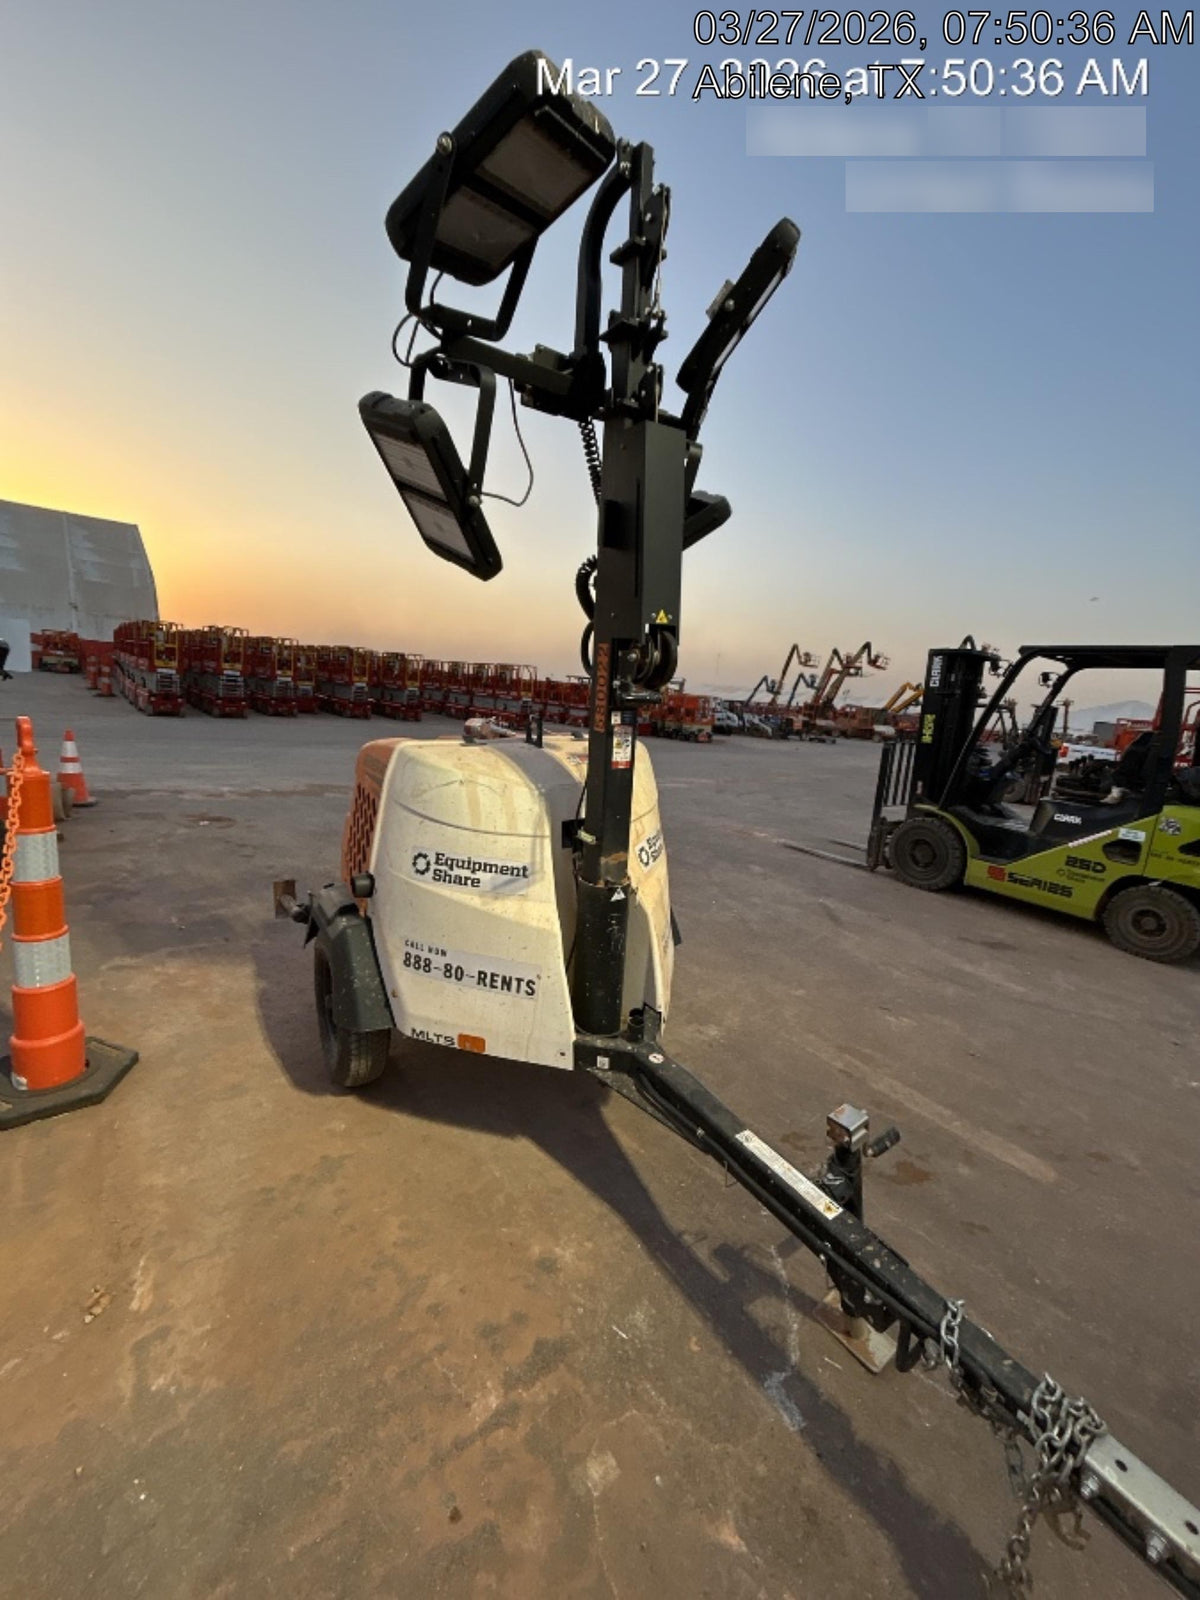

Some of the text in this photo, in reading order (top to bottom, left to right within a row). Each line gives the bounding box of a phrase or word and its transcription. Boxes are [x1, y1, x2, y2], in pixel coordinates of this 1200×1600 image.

[929, 655, 944, 688] CLARK
[432, 868, 481, 888] Share
[434, 851, 529, 879] Equipment
[405, 939, 425, 952] CALL
[403, 951, 536, 997] 888-80-RENTS
